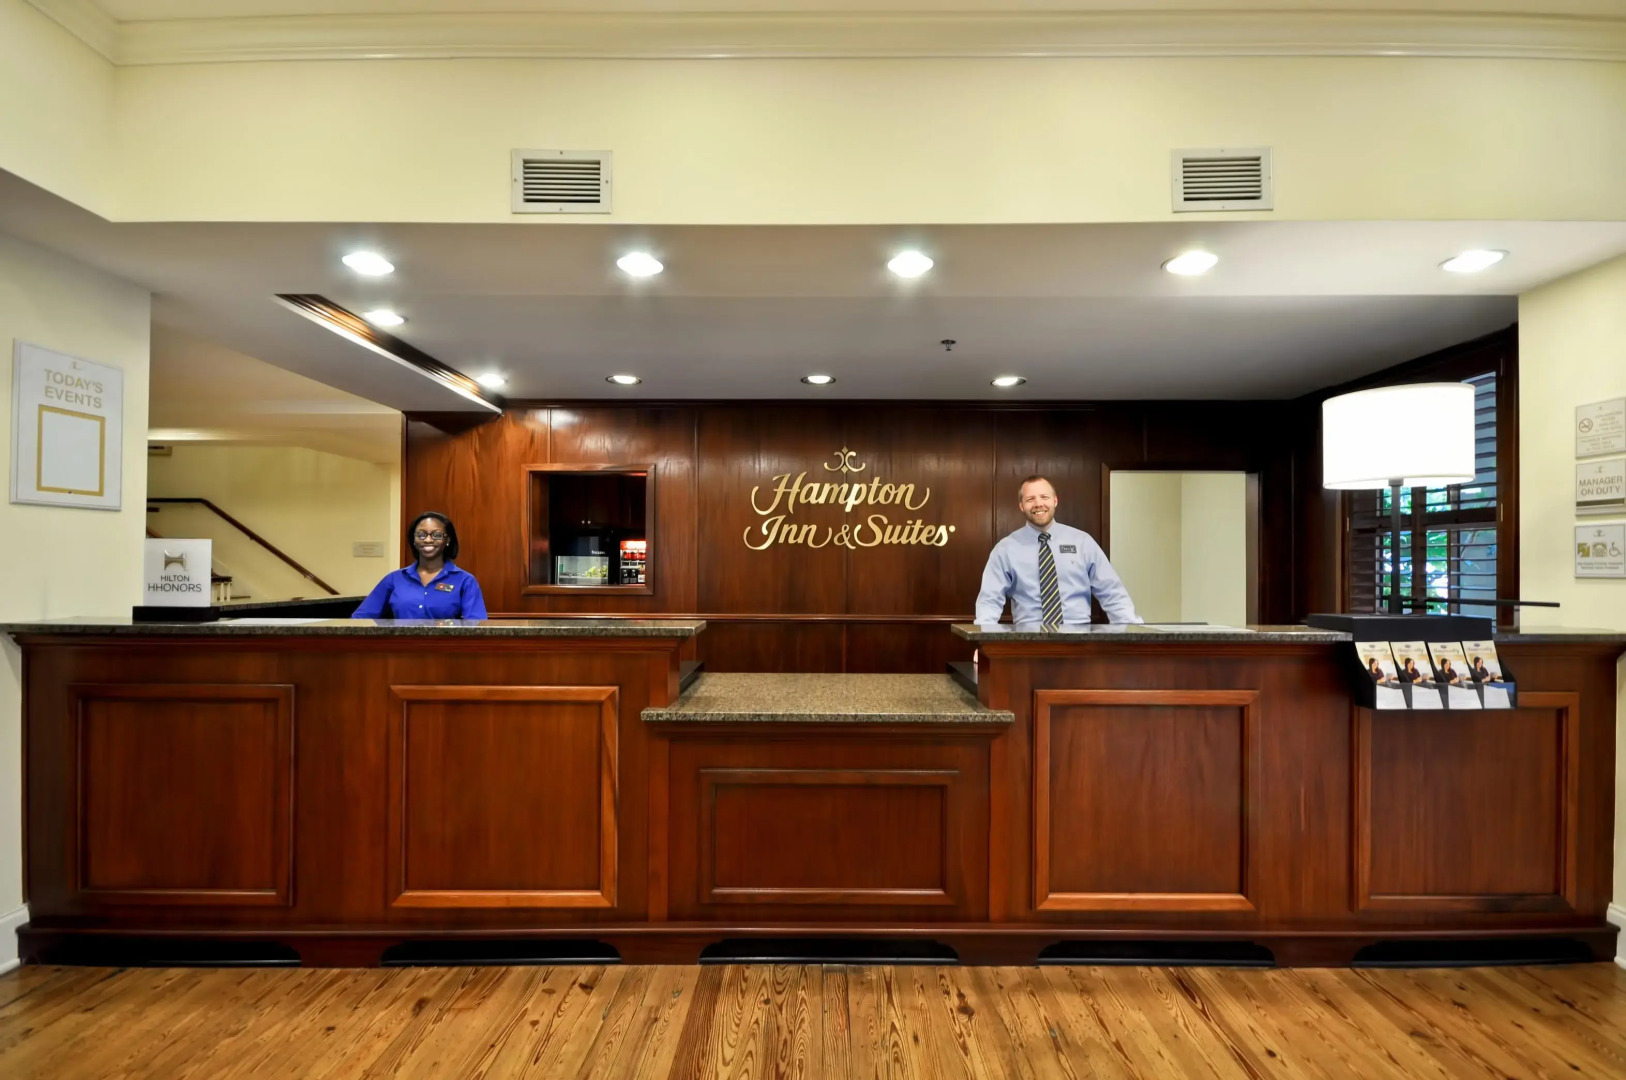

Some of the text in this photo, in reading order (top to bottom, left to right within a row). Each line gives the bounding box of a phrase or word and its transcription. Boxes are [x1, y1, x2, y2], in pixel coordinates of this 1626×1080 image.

[43, 368, 104, 394] TODAY'S
[44, 385, 102, 409] EVENTS
[1578, 475, 1623, 487] MANAGER
[751, 471, 930, 515] Hampton
[1580, 485, 1621, 496] ON DUTY
[743, 514, 949, 550] Inn & Suites
[160, 574, 190, 582] HILTON
[147, 583, 202, 592] HHONORS
